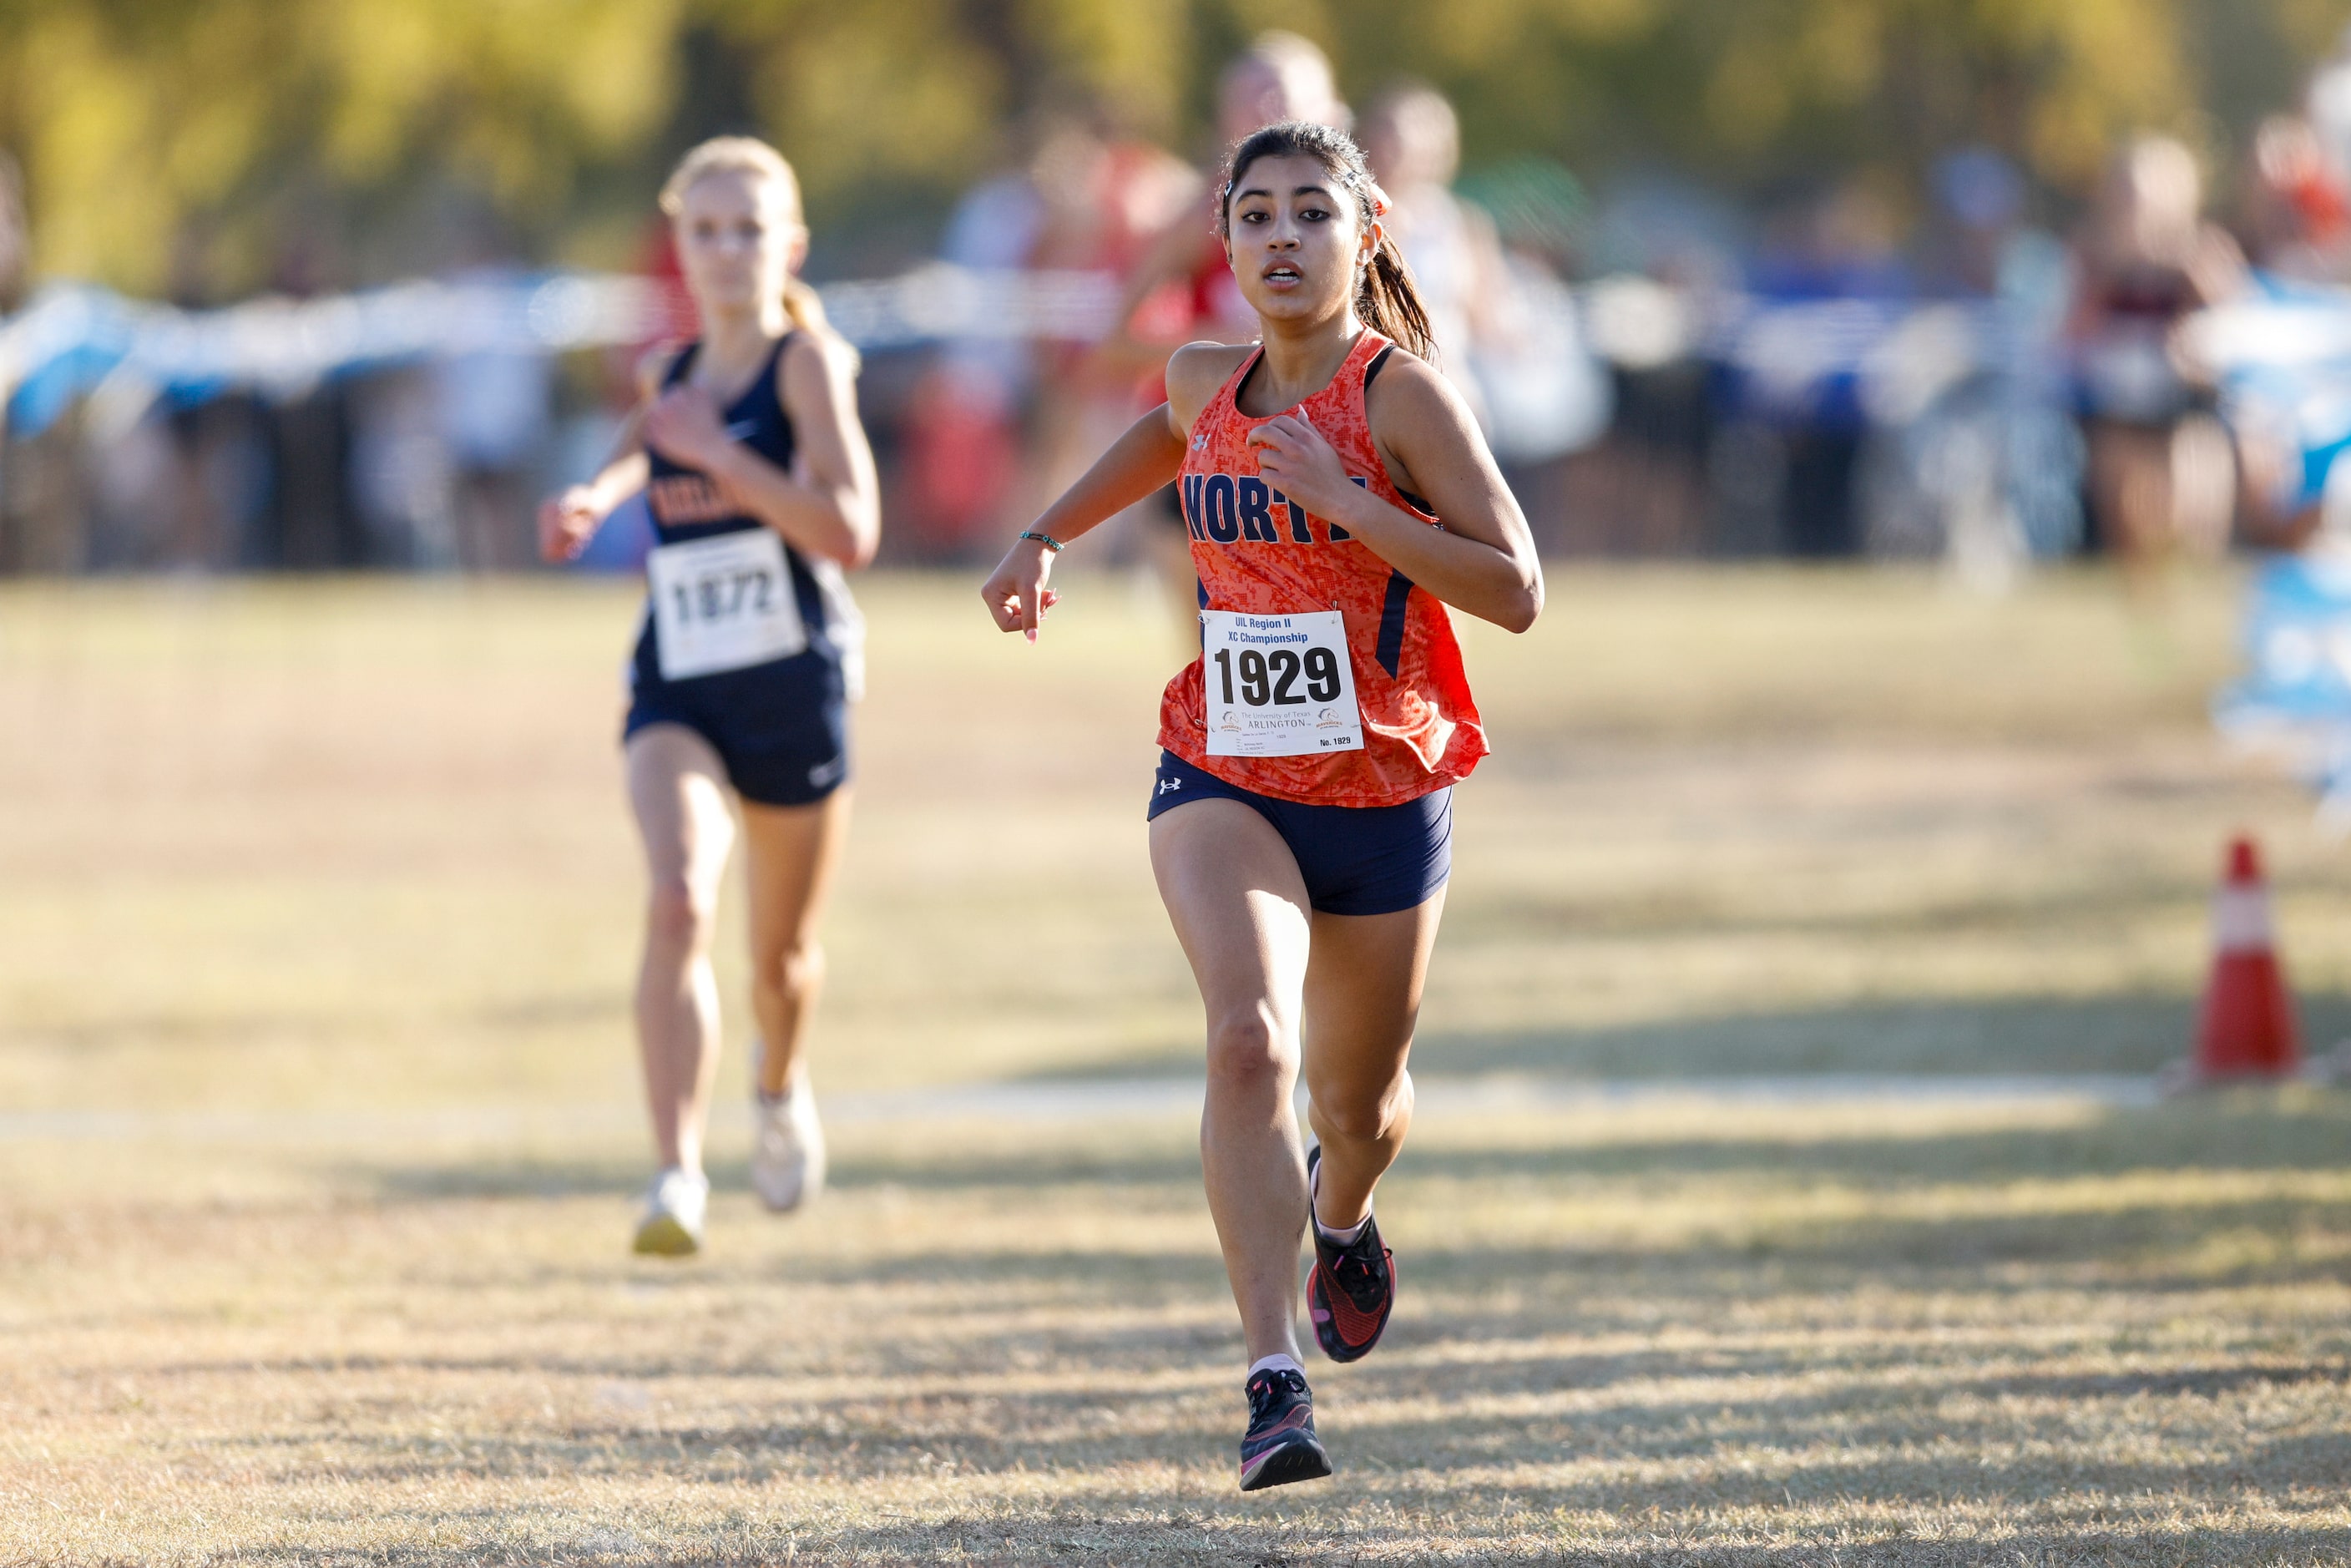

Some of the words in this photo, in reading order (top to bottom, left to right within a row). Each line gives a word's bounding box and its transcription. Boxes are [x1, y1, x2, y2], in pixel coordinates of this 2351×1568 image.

[674, 569, 775, 623] 1872
[1236, 616, 1247, 627] UIL
[1249, 618, 1282, 630] Region
[1284, 618, 1292, 628] II
[1228, 630, 1238, 642] XC
[1241, 632, 1308, 645] Championship
[1214, 646, 1342, 706] 1929
[1248, 719, 1306, 729] ARLINGTON
[1333, 736, 1351, 746] 1929
